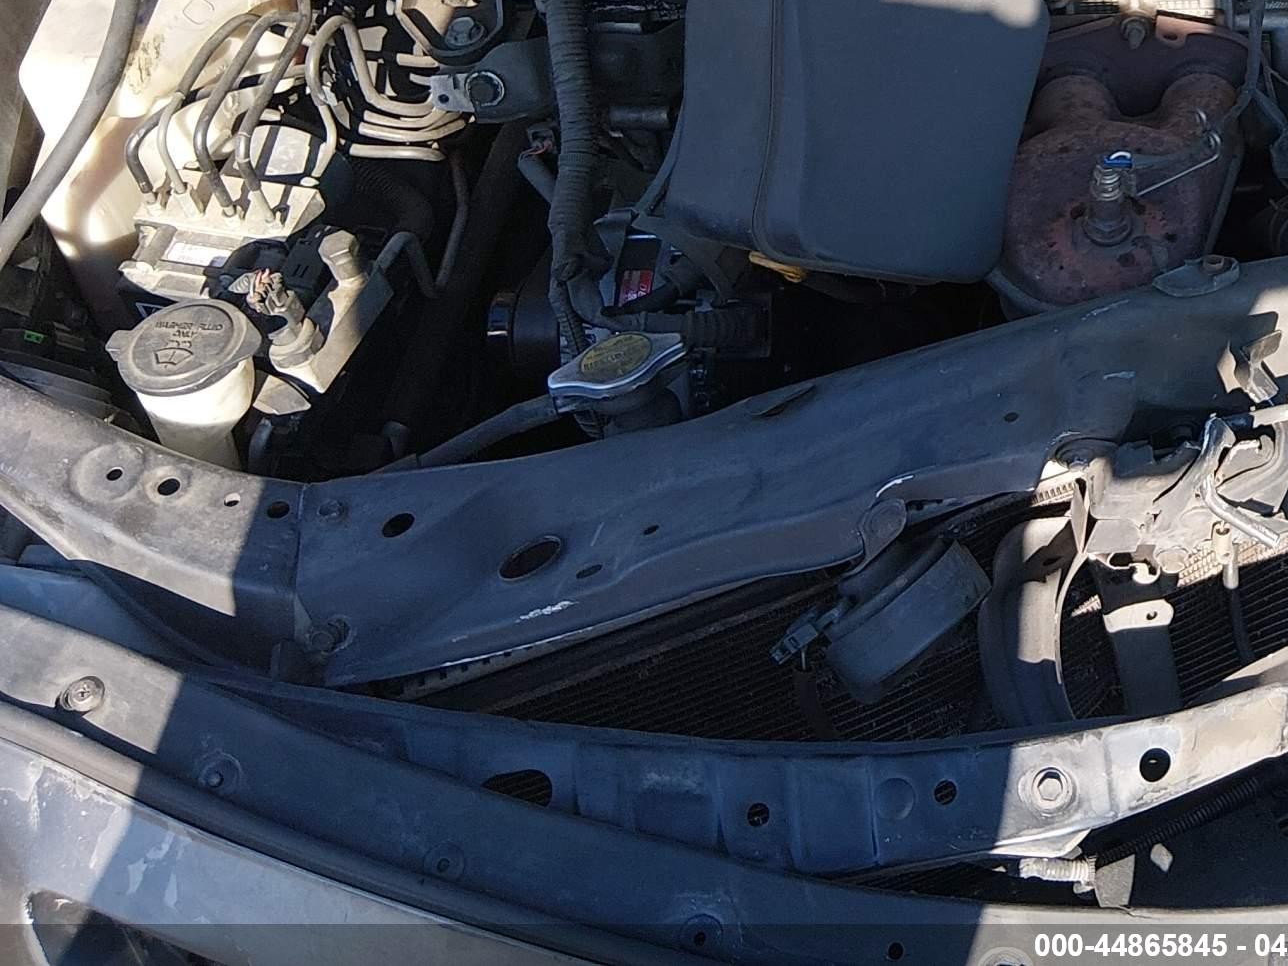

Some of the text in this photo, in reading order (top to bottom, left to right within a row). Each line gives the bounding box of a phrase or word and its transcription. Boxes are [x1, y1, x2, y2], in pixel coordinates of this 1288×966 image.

[155, 320, 224, 332] WASHER FLUID
[172, 330, 198, 339] ONLY
